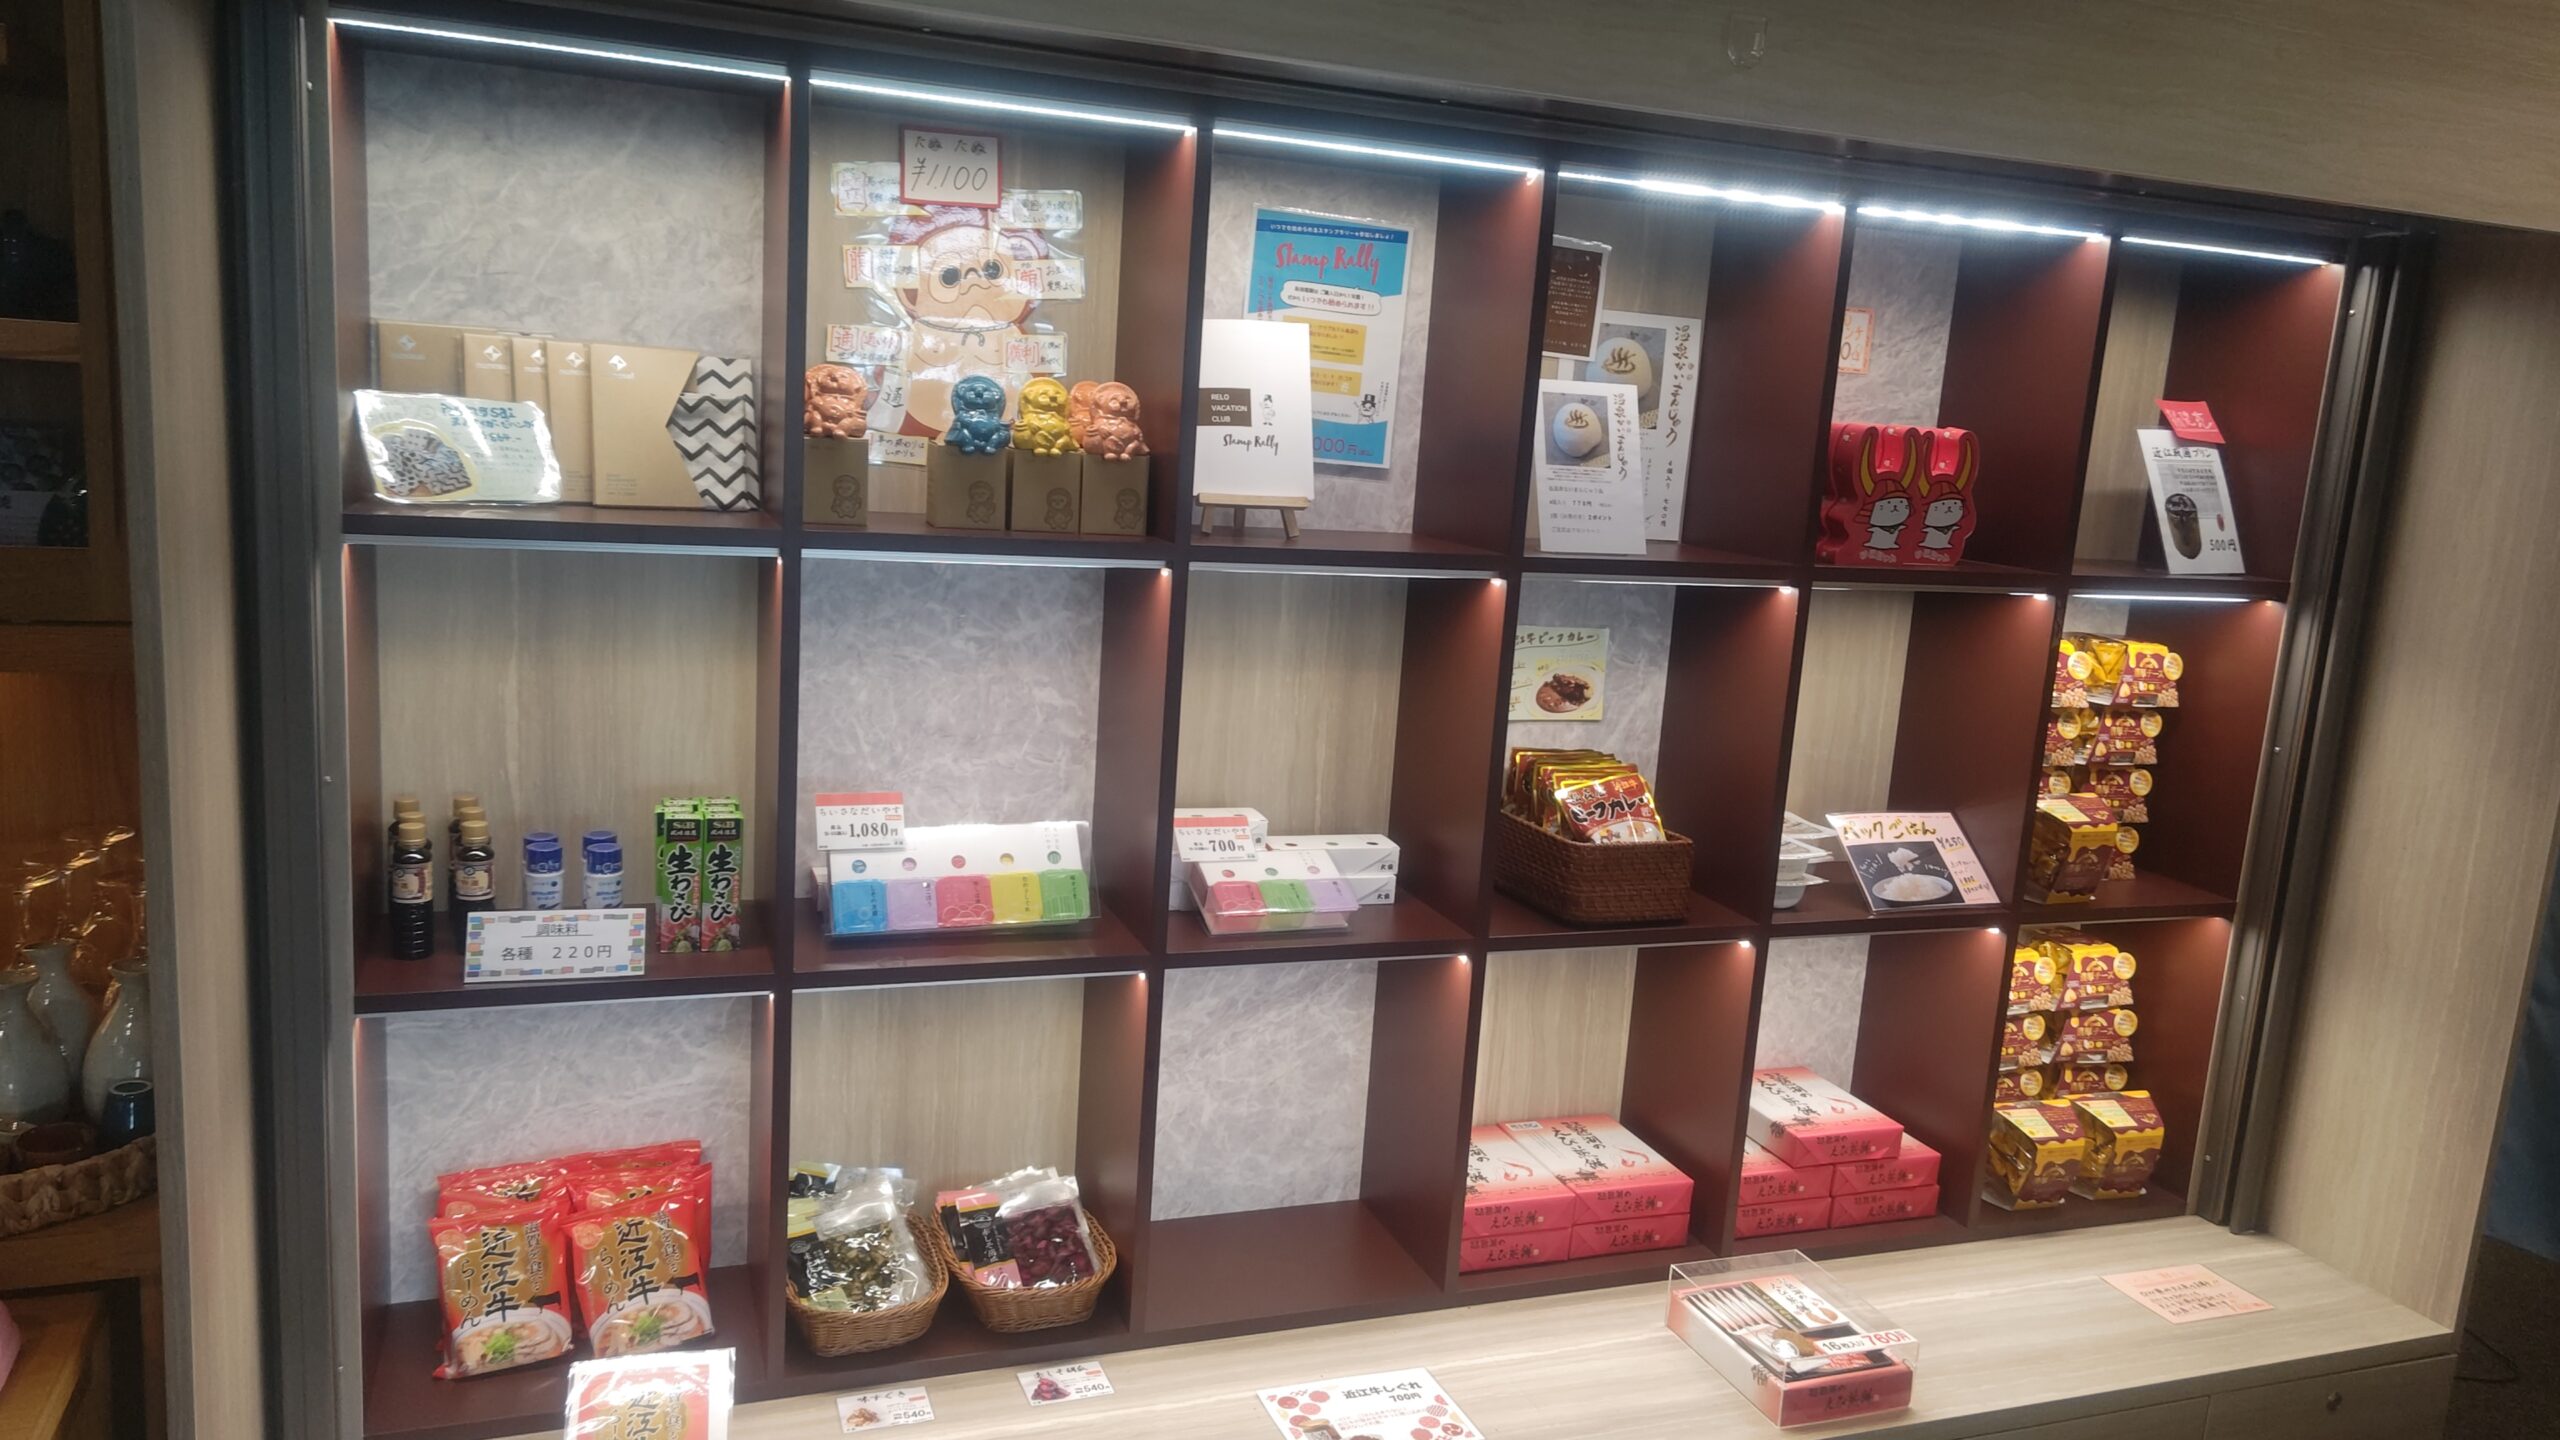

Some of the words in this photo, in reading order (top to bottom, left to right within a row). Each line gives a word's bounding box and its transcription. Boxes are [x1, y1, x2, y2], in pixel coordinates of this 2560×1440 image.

[1276, 242, 1329, 279] Stamp
[1333, 243, 1379, 286] Rally
[881, 385, 904, 408] 通
[1210, 393, 1230, 401] RELO
[1210, 404, 1248, 412] VACATION
[1211, 415, 1231, 423] CLUB
[1223, 434, 1252, 452] Stamp
[1254, 434, 1279, 456] Rally
[1208, 839, 1245, 852] 700円
[666, 843, 698, 924] 生わさび
[706, 842, 739, 924] 生わさび
[536, 923, 579, 936] 調味料
[501, 946, 533, 961] 各種
[552, 944, 612, 960] 220円
[614, 1219, 662, 1306] 近江牛
[480, 1227, 523, 1323] 近江牛
[599, 1247, 625, 1315] らーめん
[460, 1258, 481, 1330] らーめん
[1863, 1331, 1912, 1347] 760円
[1342, 1381, 1422, 1400] 近江牛しぐれ
[1387, 1392, 1421, 1403] 700円
